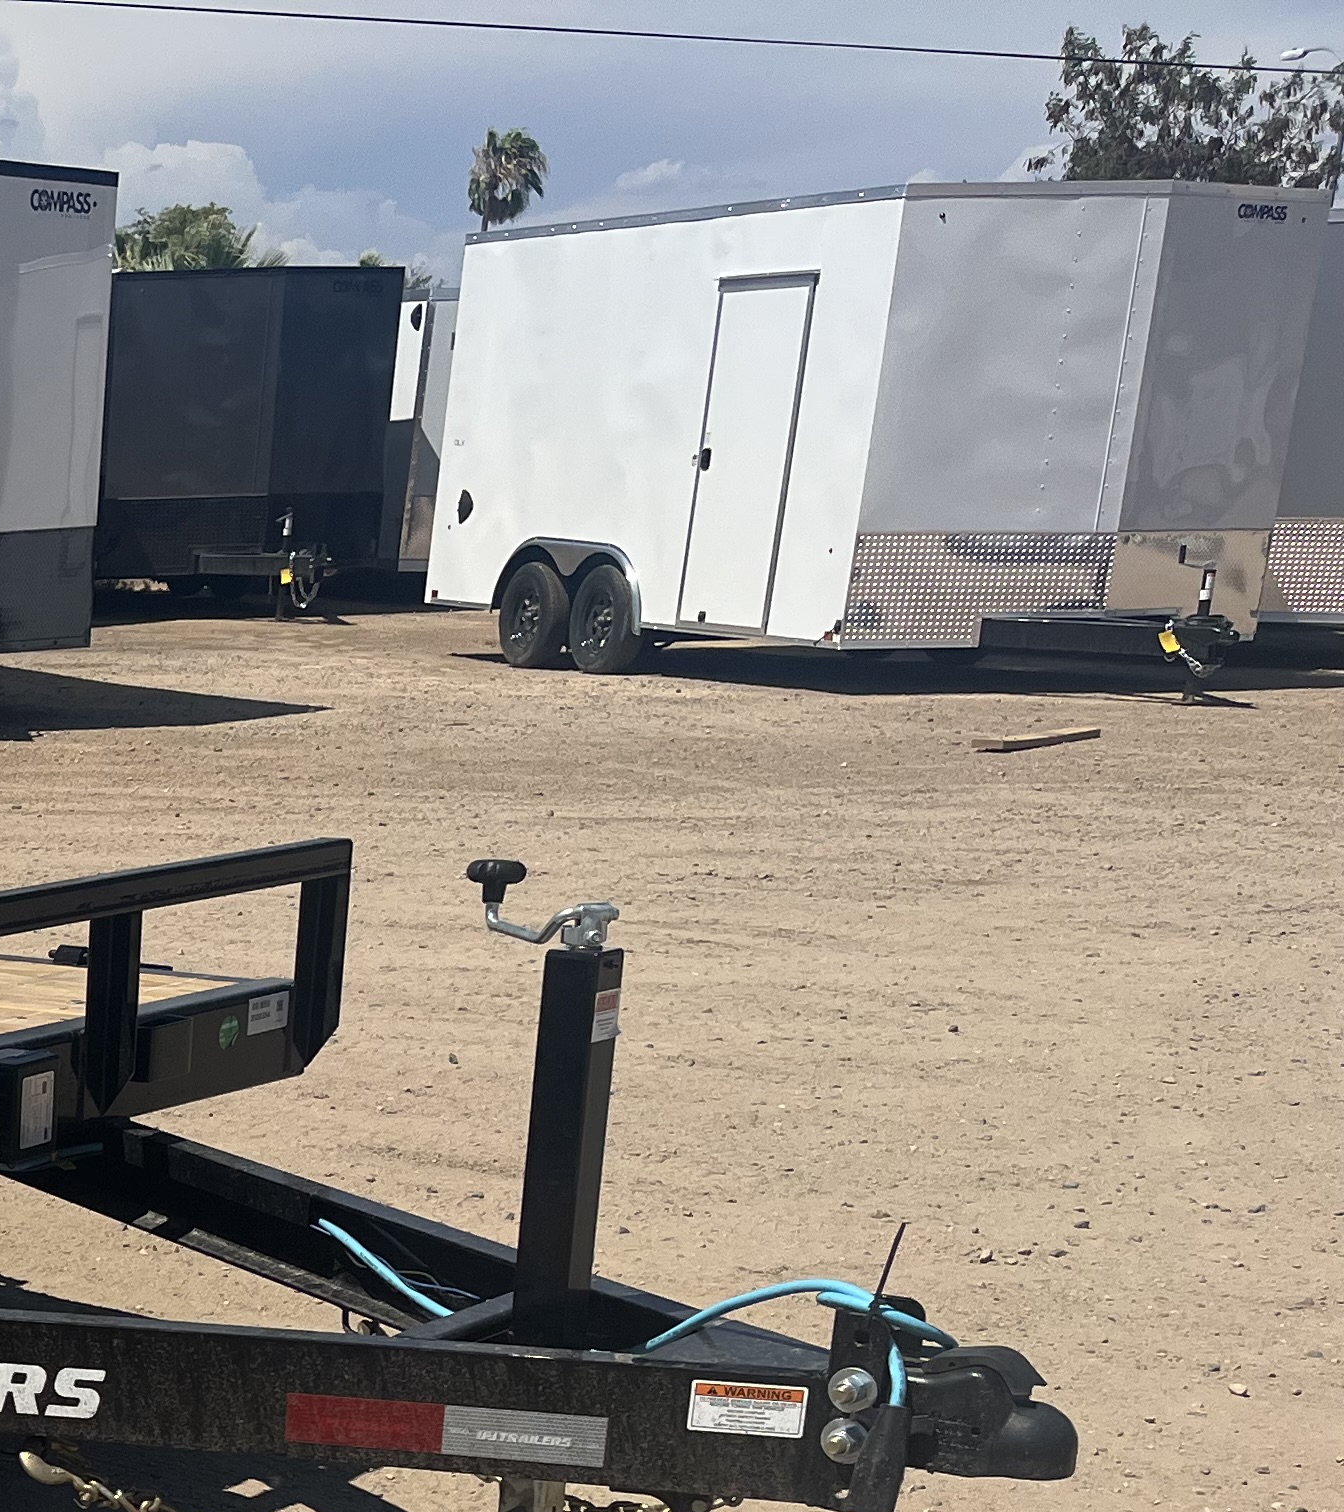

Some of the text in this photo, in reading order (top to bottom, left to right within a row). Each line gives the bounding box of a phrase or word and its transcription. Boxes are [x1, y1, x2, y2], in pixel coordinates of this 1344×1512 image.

[30, 189, 91, 214] COMPASS
[1238, 204, 1288, 221] COMPASS
[723, 1385, 793, 1401] WARNING
